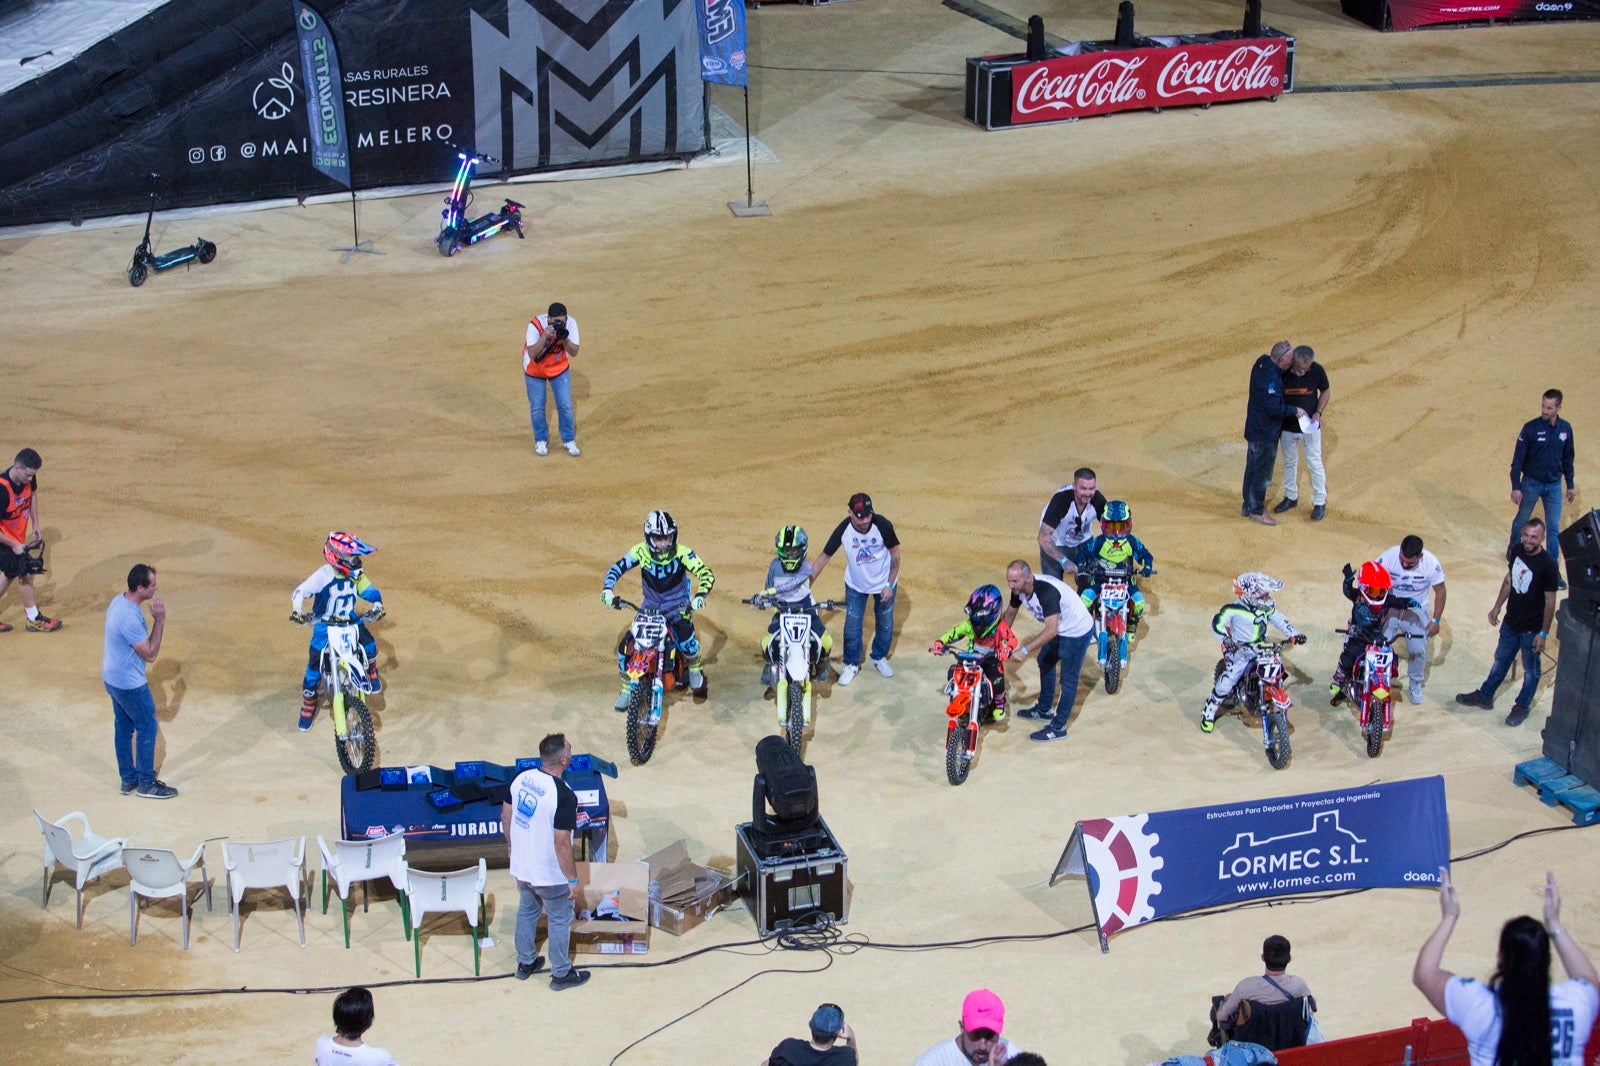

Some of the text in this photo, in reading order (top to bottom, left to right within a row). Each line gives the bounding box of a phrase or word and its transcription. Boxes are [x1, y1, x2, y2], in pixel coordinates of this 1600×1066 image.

[344, 65, 429, 82] SAS RURALES
[1156, 44, 1281, 98] Coca-Cola
[1016, 56, 1148, 114] Coca-Cola
[240, 123, 453, 159] @MAI MELERO
[792, 626, 799, 640] 1
[1263, 664, 1281, 678] 17
[1206, 809, 1244, 820] Estructuras
[1245, 807, 1261, 815] Para
[1263, 803, 1294, 814] Deportes
[1301, 797, 1335, 810] Proyectos
[1336, 796, 1346, 804] de
[1346, 790, 1381, 803] Ingeniería
[1218, 843, 1369, 880] LORMEC S.L.
[1236, 871, 1356, 893] www.lormec.com
[1403, 870, 1435, 882] daen
